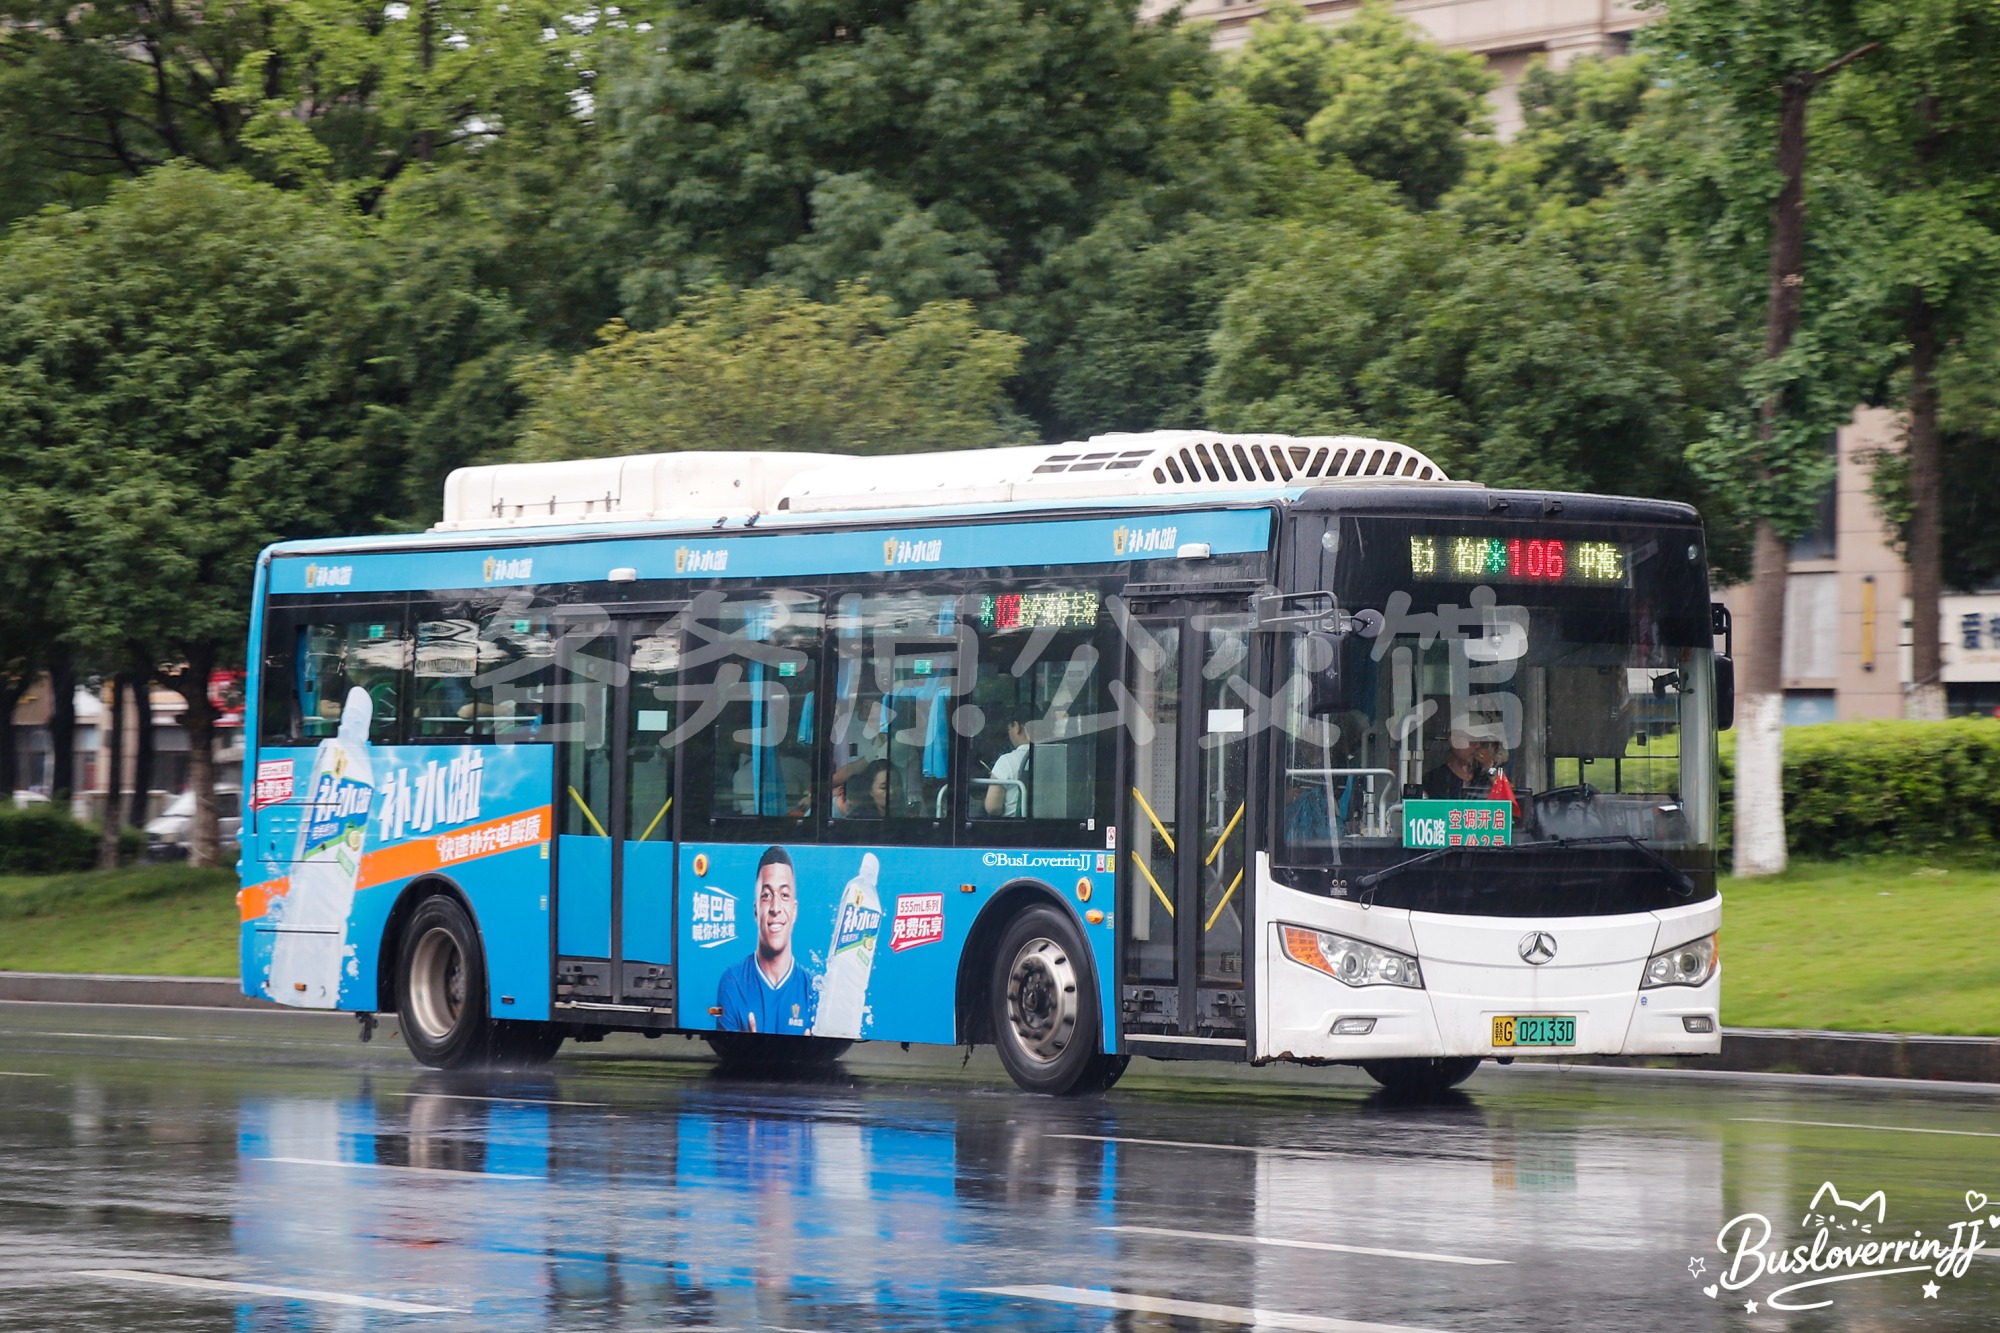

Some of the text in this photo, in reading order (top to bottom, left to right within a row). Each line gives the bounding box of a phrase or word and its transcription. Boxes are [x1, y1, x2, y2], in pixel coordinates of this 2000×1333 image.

[897, 539, 942, 564] 补水啦
[1128, 527, 1178, 553] 补水啦
[495, 558, 533, 580] 补水啦
[687, 549, 729, 572] 补水啦
[1509, 539, 1564, 577] 106
[316, 565, 353, 586] 补水啦
[995, 594, 1020, 629] 106
[314, 778, 373, 823] 补水啦
[378, 749, 485, 842] 补水啦
[1409, 818, 1446, 846] 106路
[1448, 809, 1505, 830] 空调开启
[438, 814, 542, 863] 快速补充电解质
[692, 891, 736, 922] 姆巴佩
[843, 906, 881, 934] 补水啦
[900, 899, 940, 913] 555mL系列
[692, 922, 736, 942] 喊你补水啦
[890, 916, 943, 945] 免费乐享
